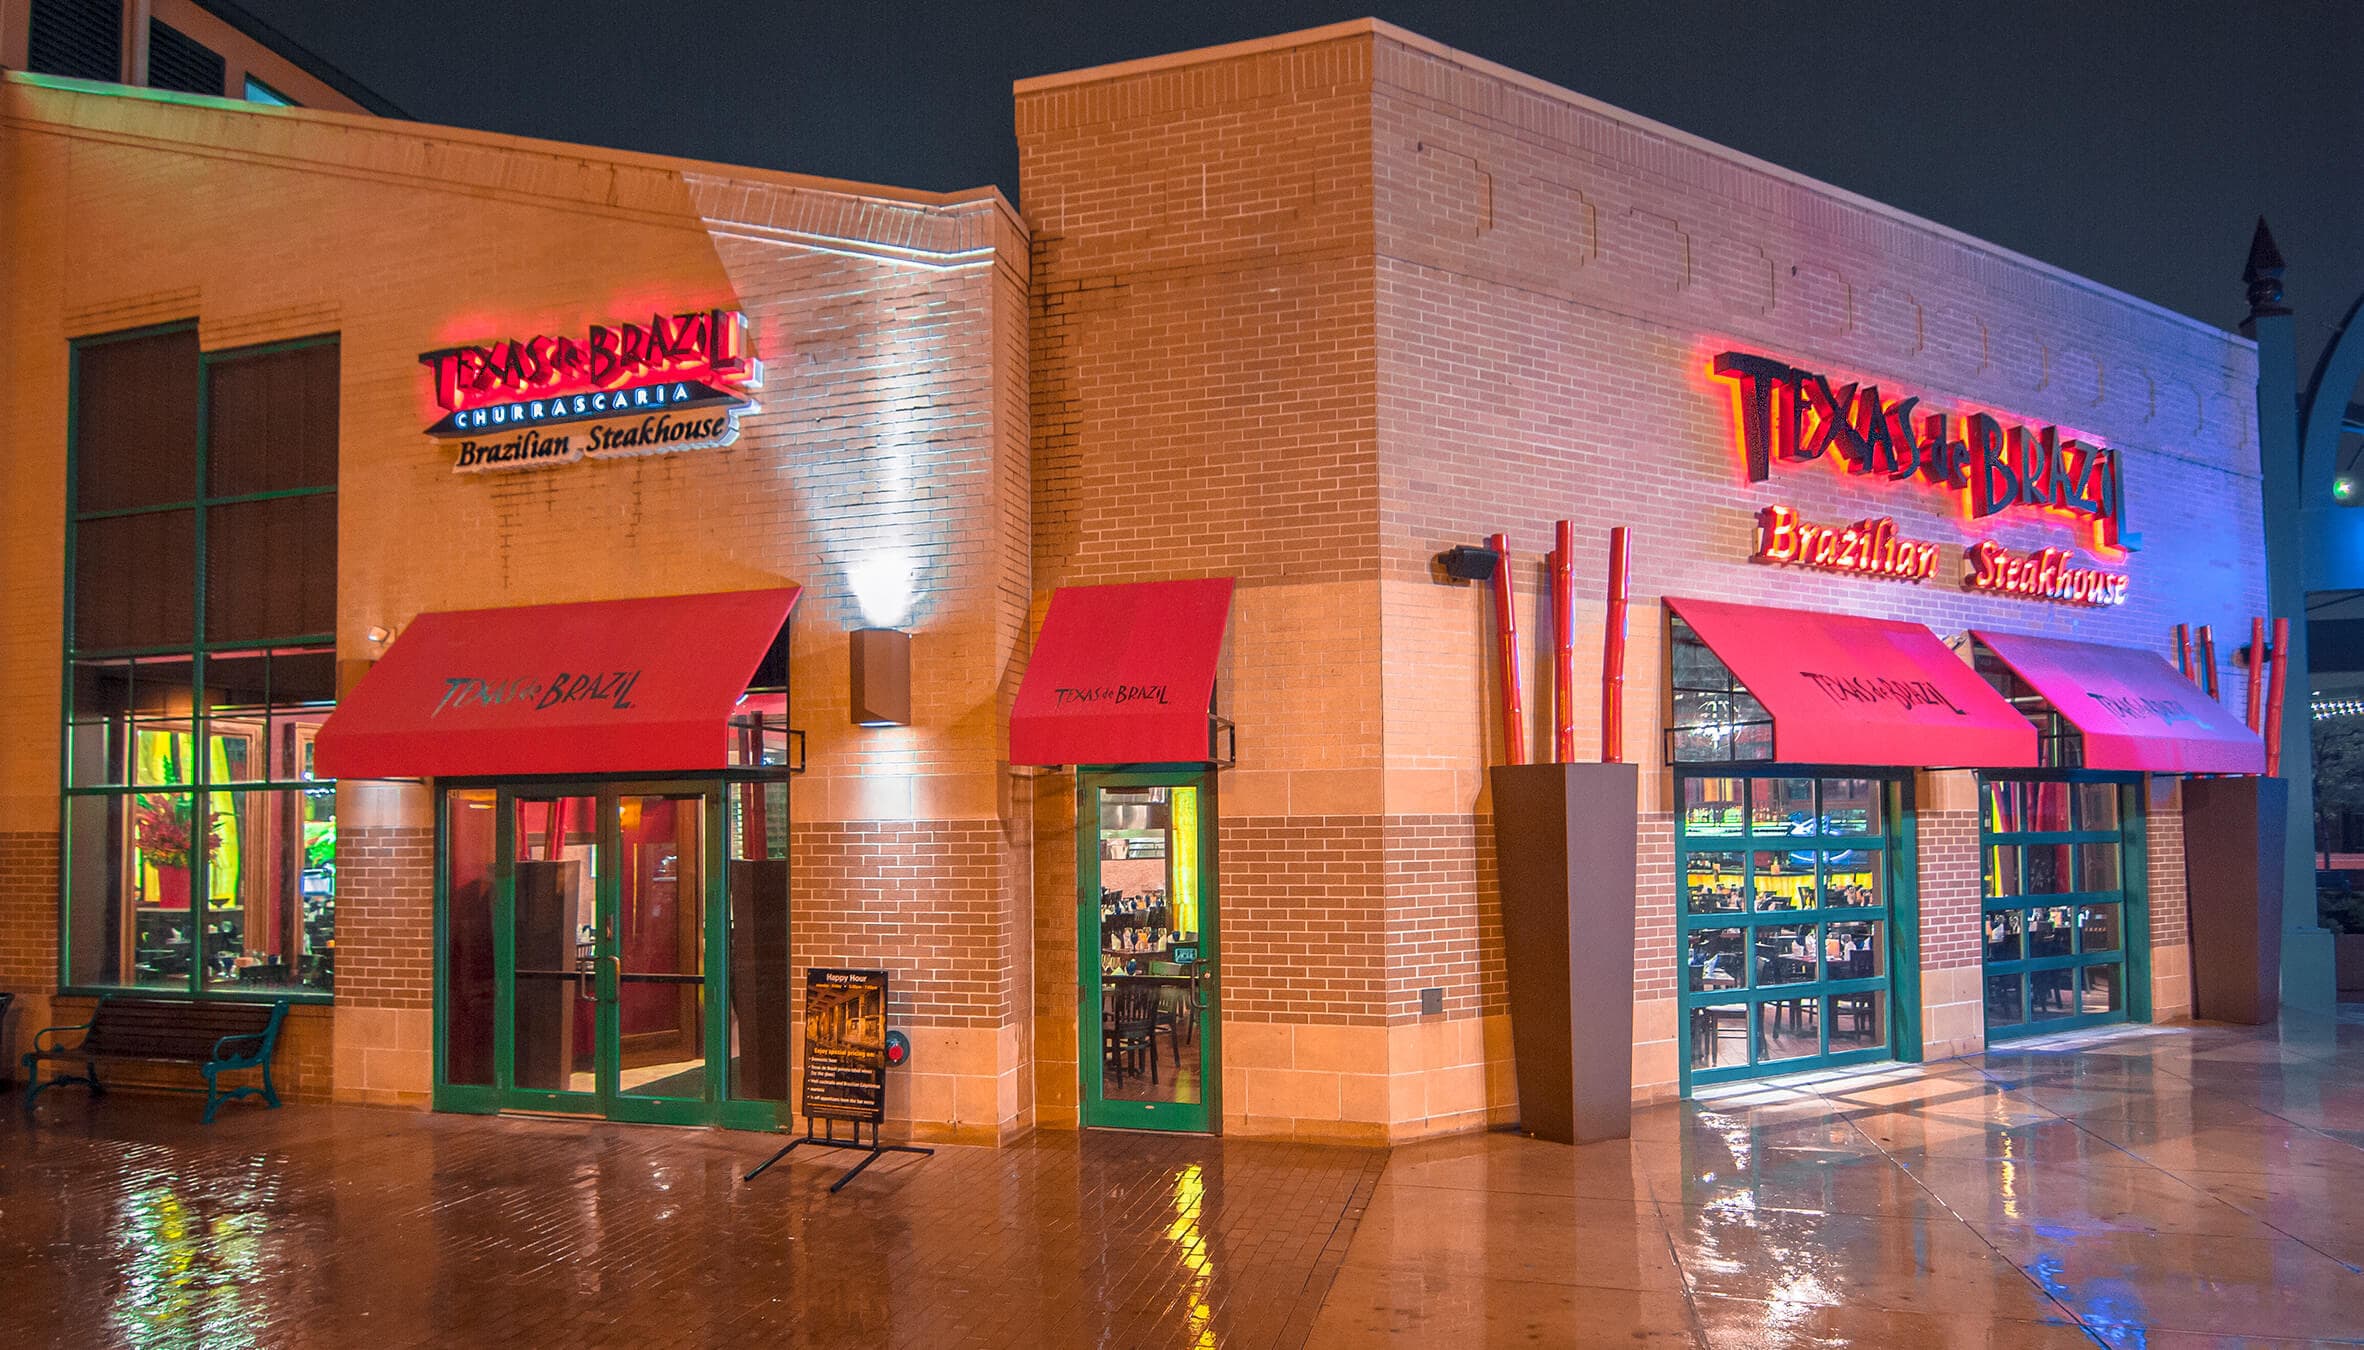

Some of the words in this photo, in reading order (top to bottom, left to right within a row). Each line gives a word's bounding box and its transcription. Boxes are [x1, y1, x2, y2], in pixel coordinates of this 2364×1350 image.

[419, 335, 552, 411] TEXAS
[455, 382, 689, 429] CHURRASCARIA
[1713, 351, 1920, 482] TEXAS
[1920, 413, 1969, 490] de
[456, 430, 569, 467] Brazilian
[586, 412, 725, 452] Steakhouse
[1763, 504, 1941, 580] Brazilian
[1972, 538, 2130, 606] Steakhouse
[431, 676, 528, 719] TEXAS
[1055, 687, 1102, 708] TEXAS
[1799, 671, 1877, 710] TEXAS
[826, 973, 848, 983] Happy
[849, 974, 867, 982] Hour
